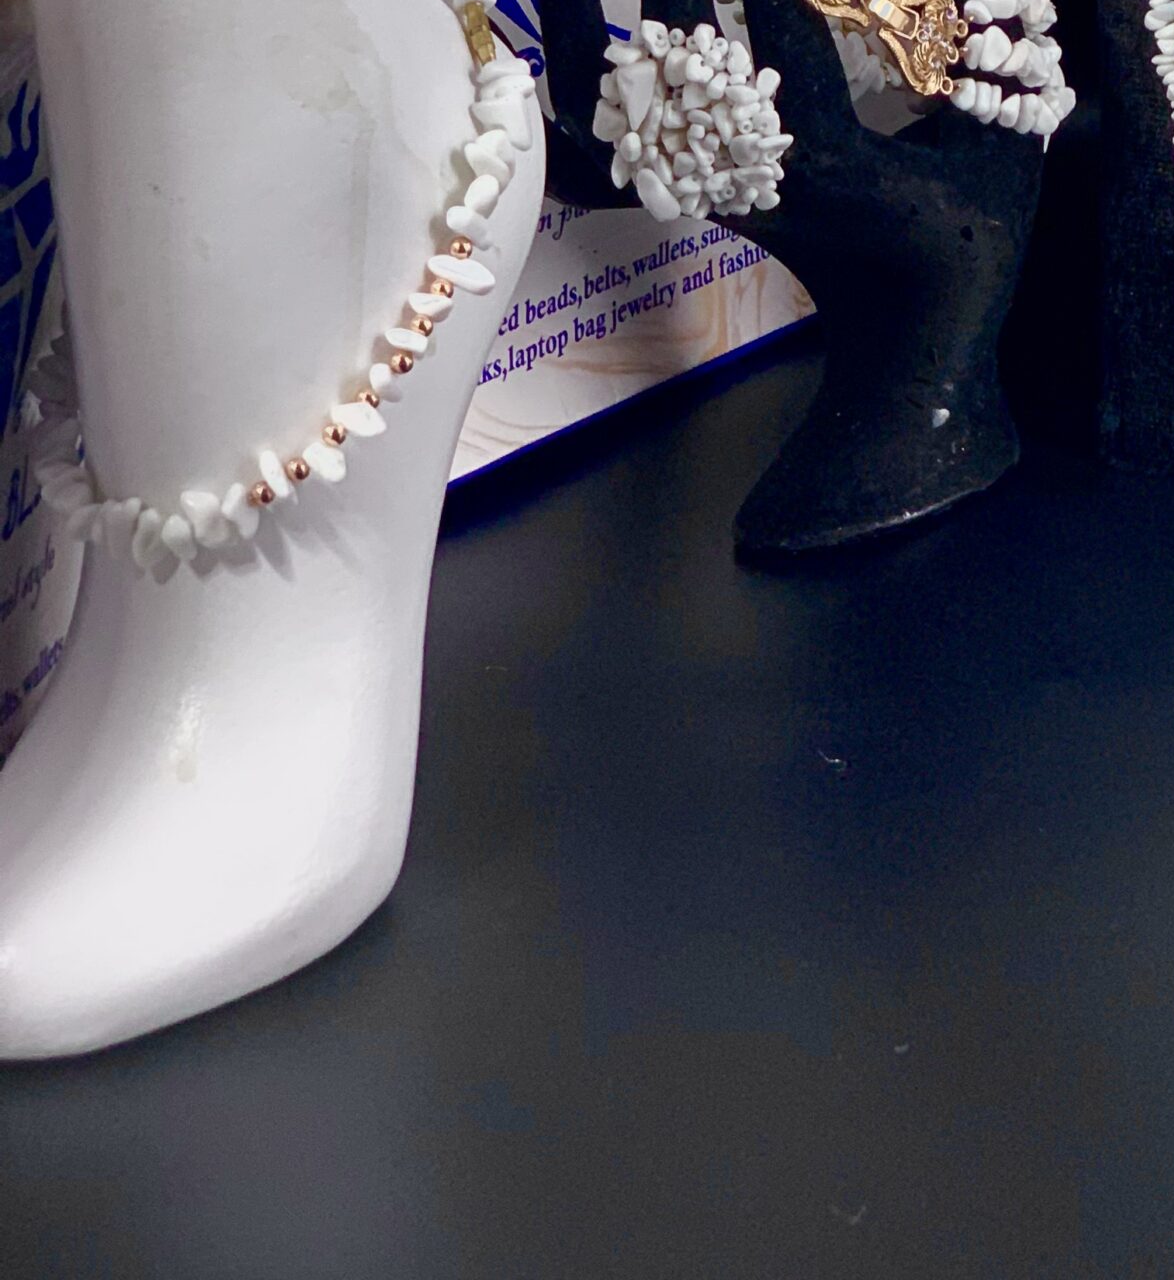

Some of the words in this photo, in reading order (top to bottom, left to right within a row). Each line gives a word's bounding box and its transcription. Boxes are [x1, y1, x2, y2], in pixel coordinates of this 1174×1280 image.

[573, 313, 607, 345] bag
[608, 280, 677, 336] jewelry
[681, 259, 715, 296] and
